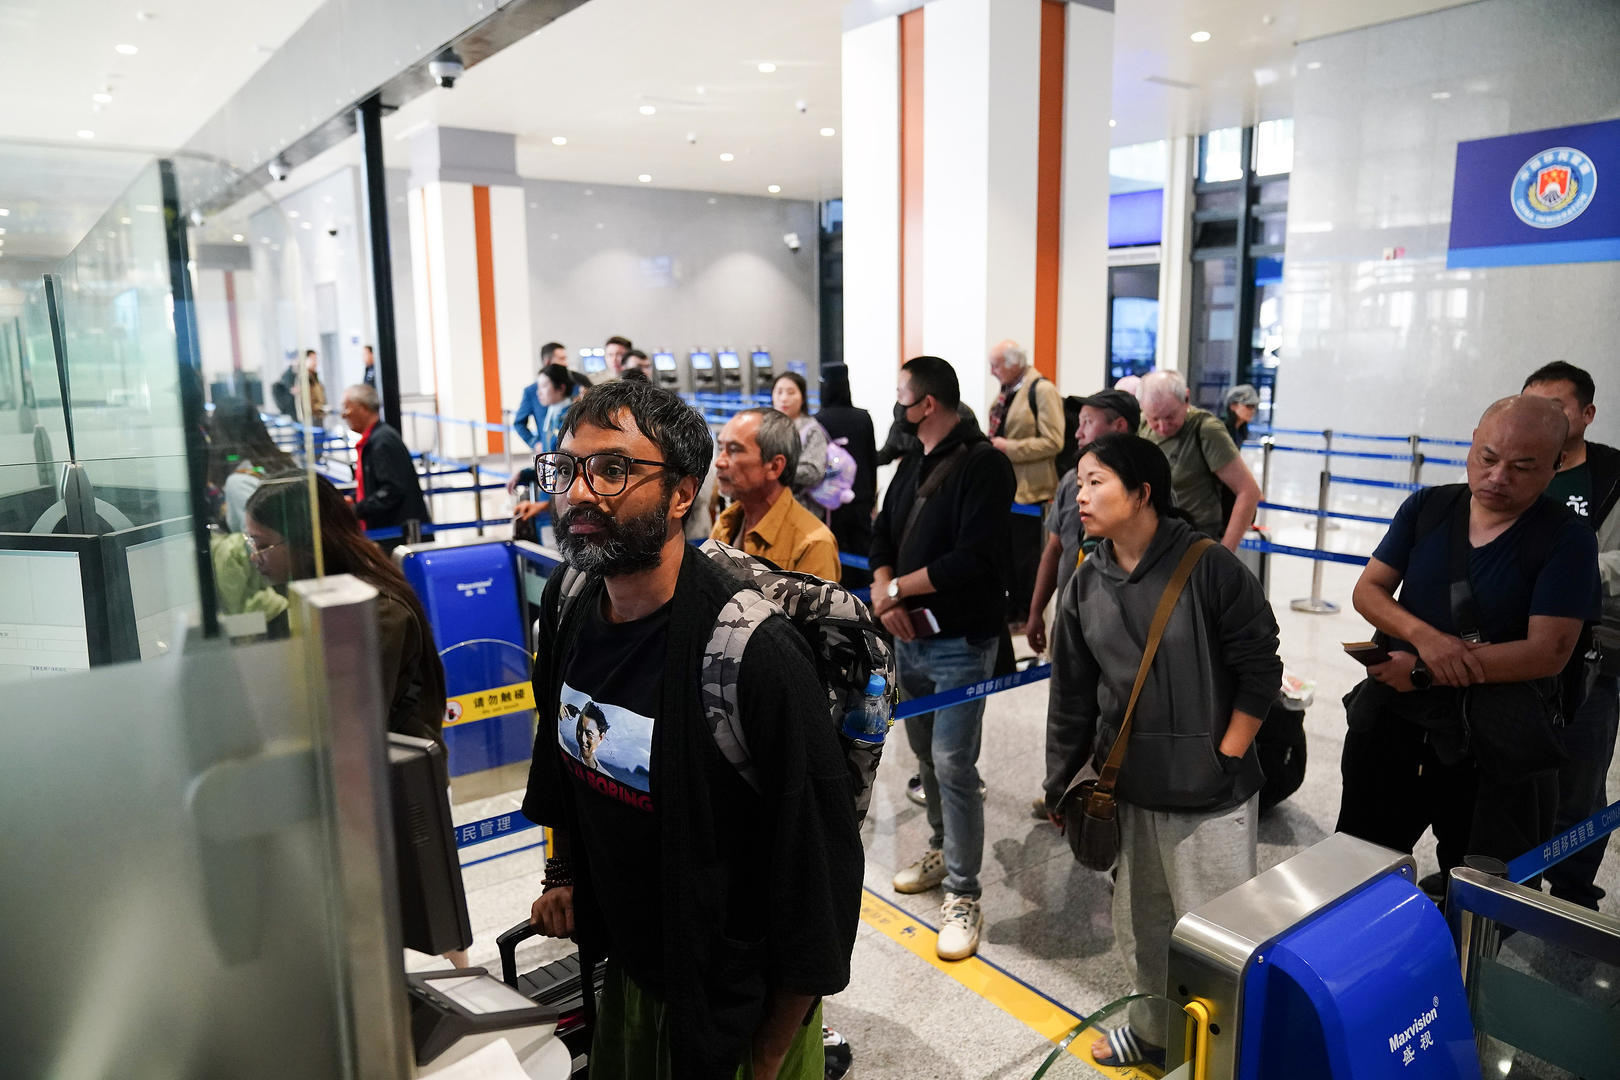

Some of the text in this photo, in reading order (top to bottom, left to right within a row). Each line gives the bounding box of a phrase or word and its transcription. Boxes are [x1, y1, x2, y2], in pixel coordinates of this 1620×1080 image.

[1543, 820, 1595, 862] 中国移民管理
